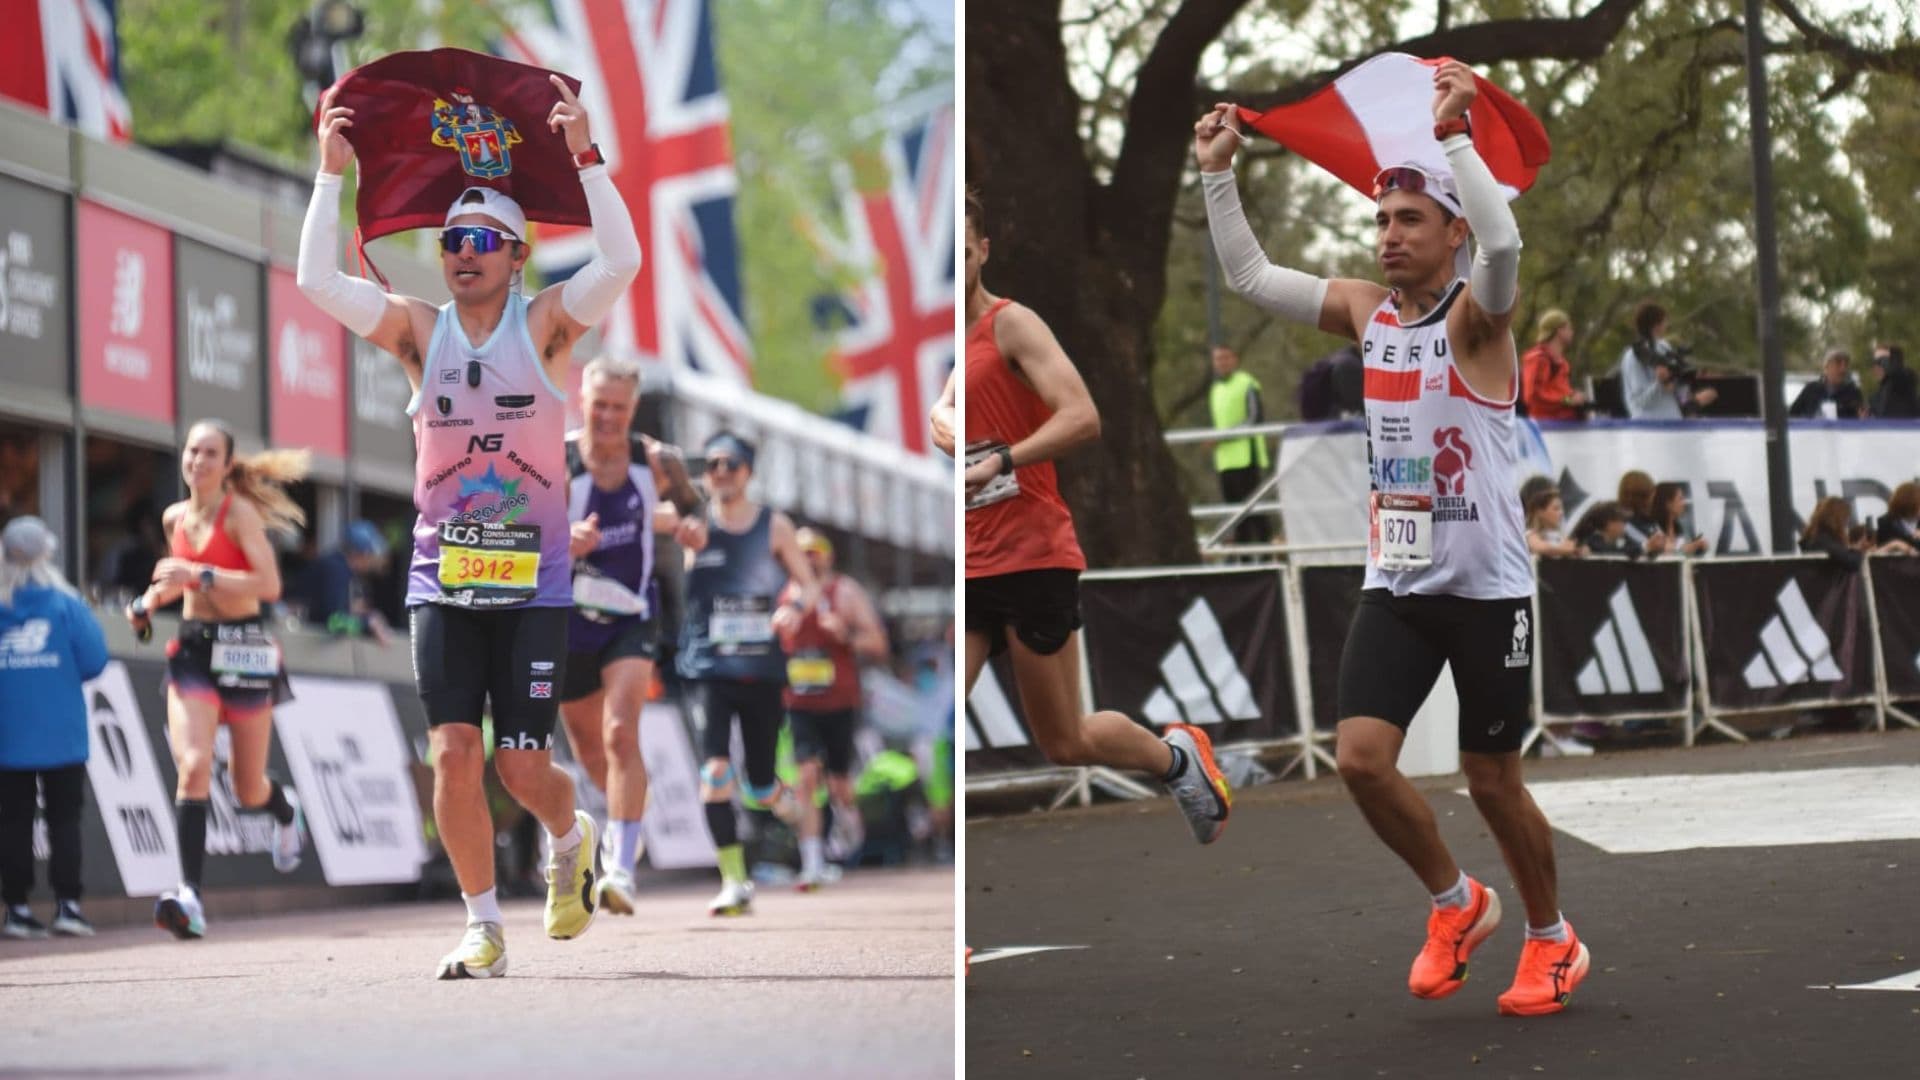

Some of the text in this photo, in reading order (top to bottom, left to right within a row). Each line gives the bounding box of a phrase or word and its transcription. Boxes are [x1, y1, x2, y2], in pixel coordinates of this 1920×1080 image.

[1364, 338, 1447, 363] PERU
[427, 418, 474, 428] CAMOTORS
[495, 409, 536, 421] GEELY
[466, 433, 504, 454] NG
[426, 450, 552, 490] Gobierno Regional
[1437, 496, 1467, 508] FUERZA
[443, 522, 505, 545] tcs TATA
[482, 530, 533, 539] CONSULTANCY
[1384, 518, 1416, 544] 1870
[481, 538, 516, 546] SERVICES
[457, 557, 514, 580] 3912
